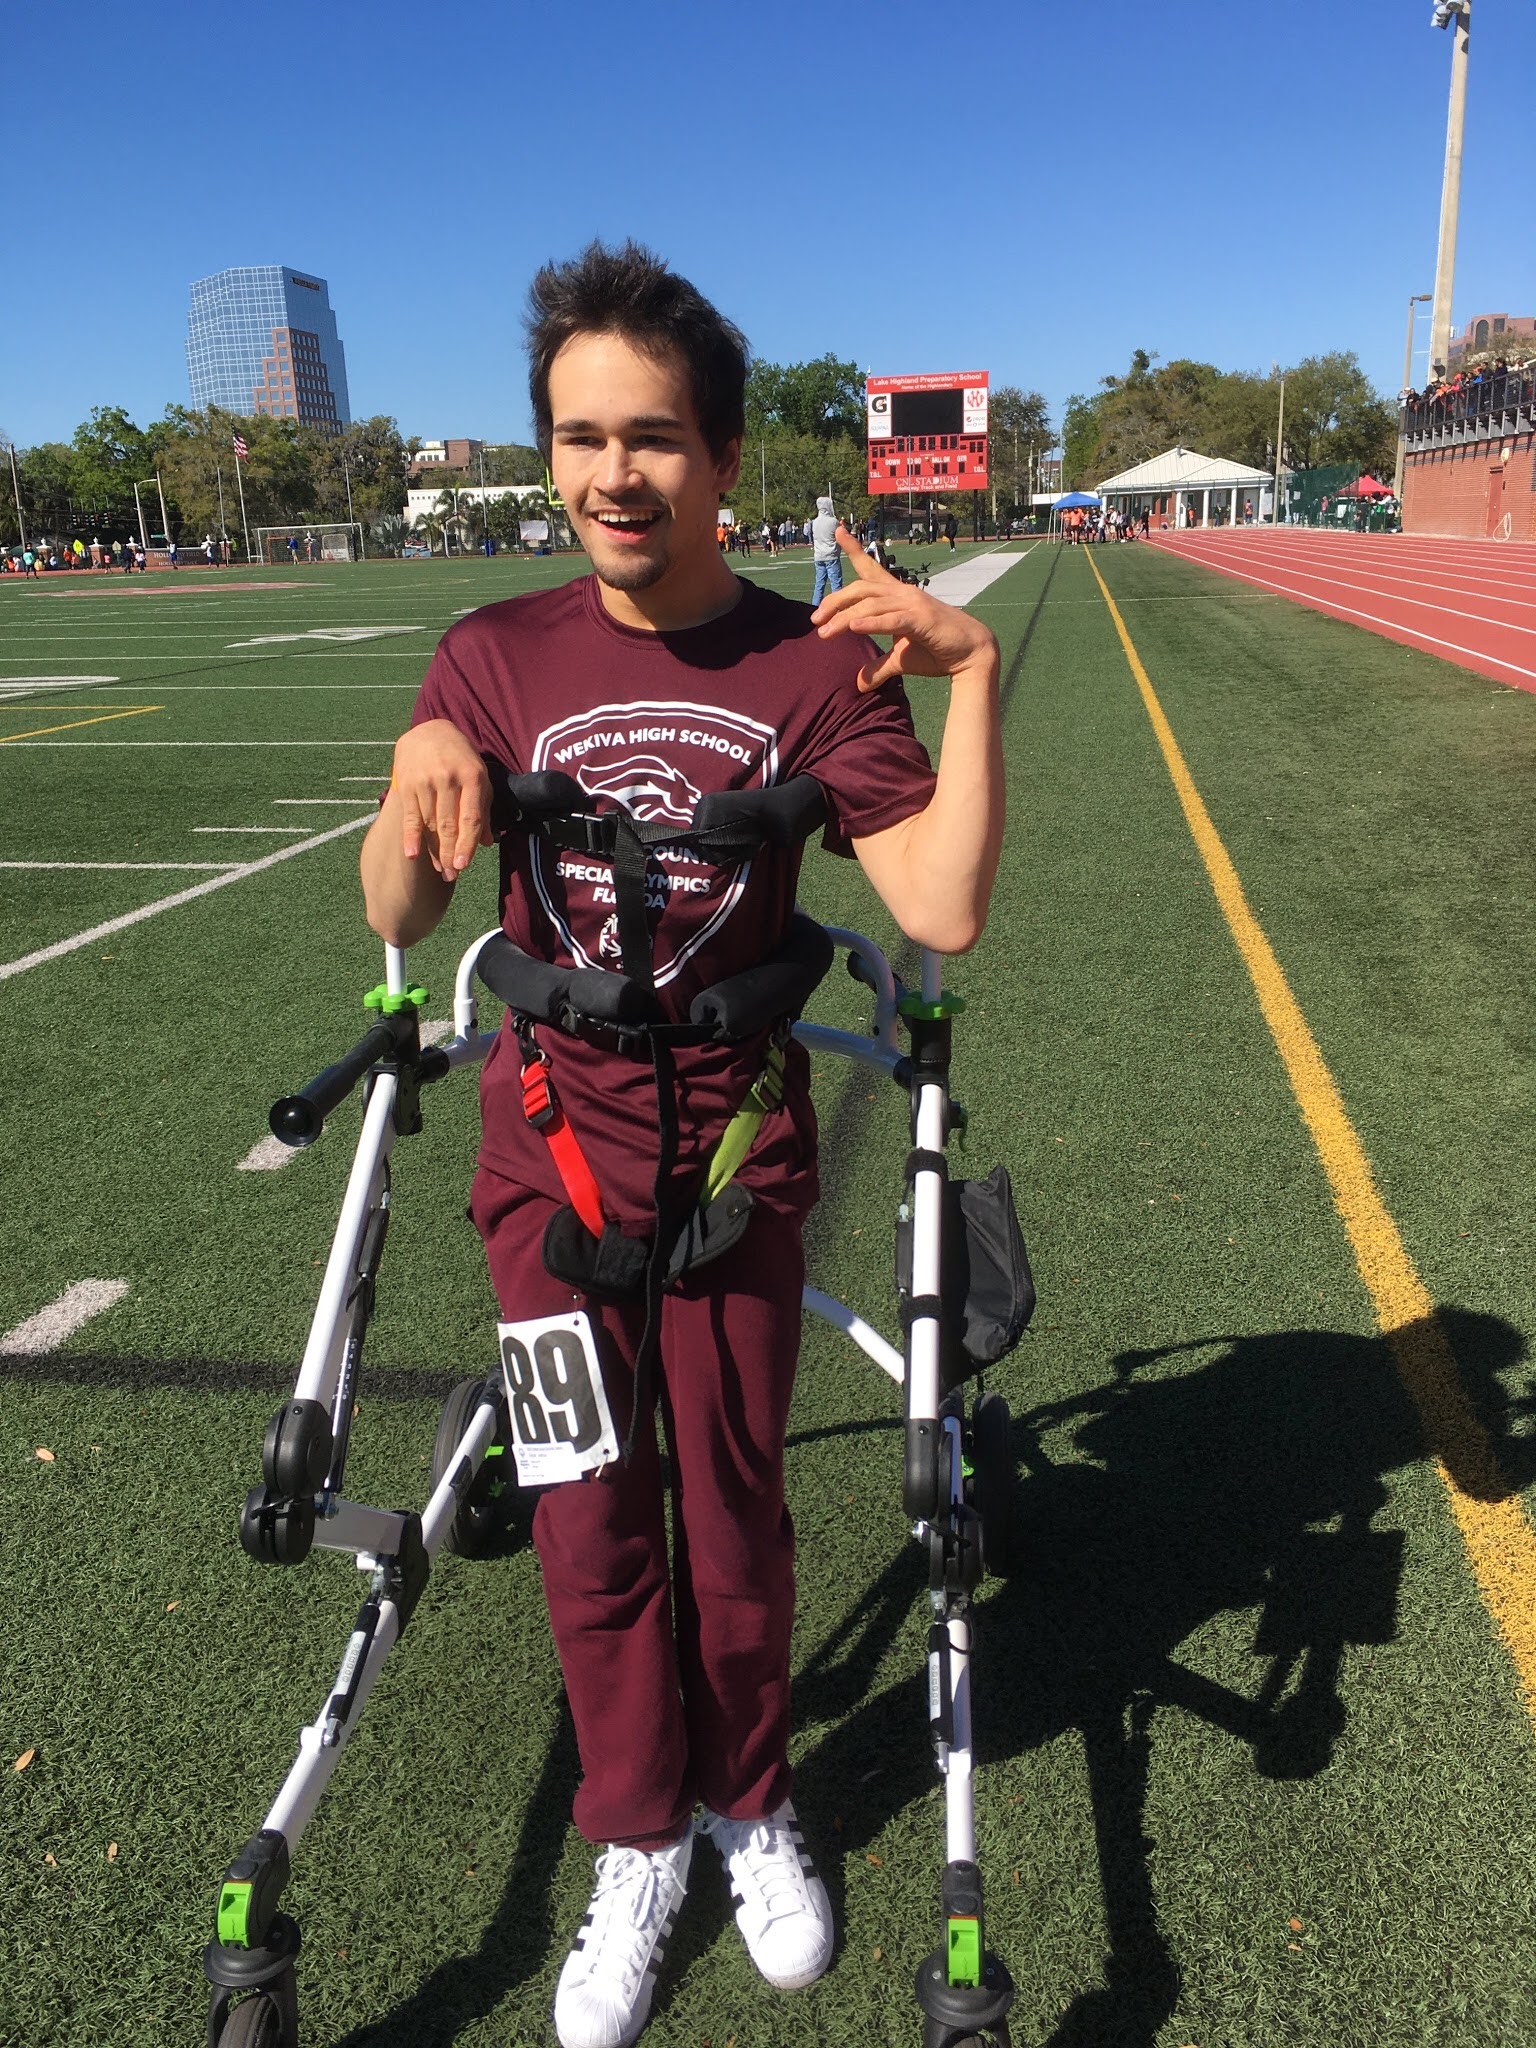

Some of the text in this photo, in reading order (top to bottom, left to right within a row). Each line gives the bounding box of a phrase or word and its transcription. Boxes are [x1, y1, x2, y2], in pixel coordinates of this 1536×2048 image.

[890, 377, 919, 386] Highland
[920, 375, 957, 384] Preparatory
[959, 373, 982, 381] School
[871, 395, 888, 413] G
[915, 475, 959, 486] STADIUM
[553, 727, 752, 766] WEKIVA HIGH SCHOOL
[643, 845, 709, 866] COUN
[555, 862, 712, 894] SPECIA YMPICS
[502, 1329, 602, 1453] 89
